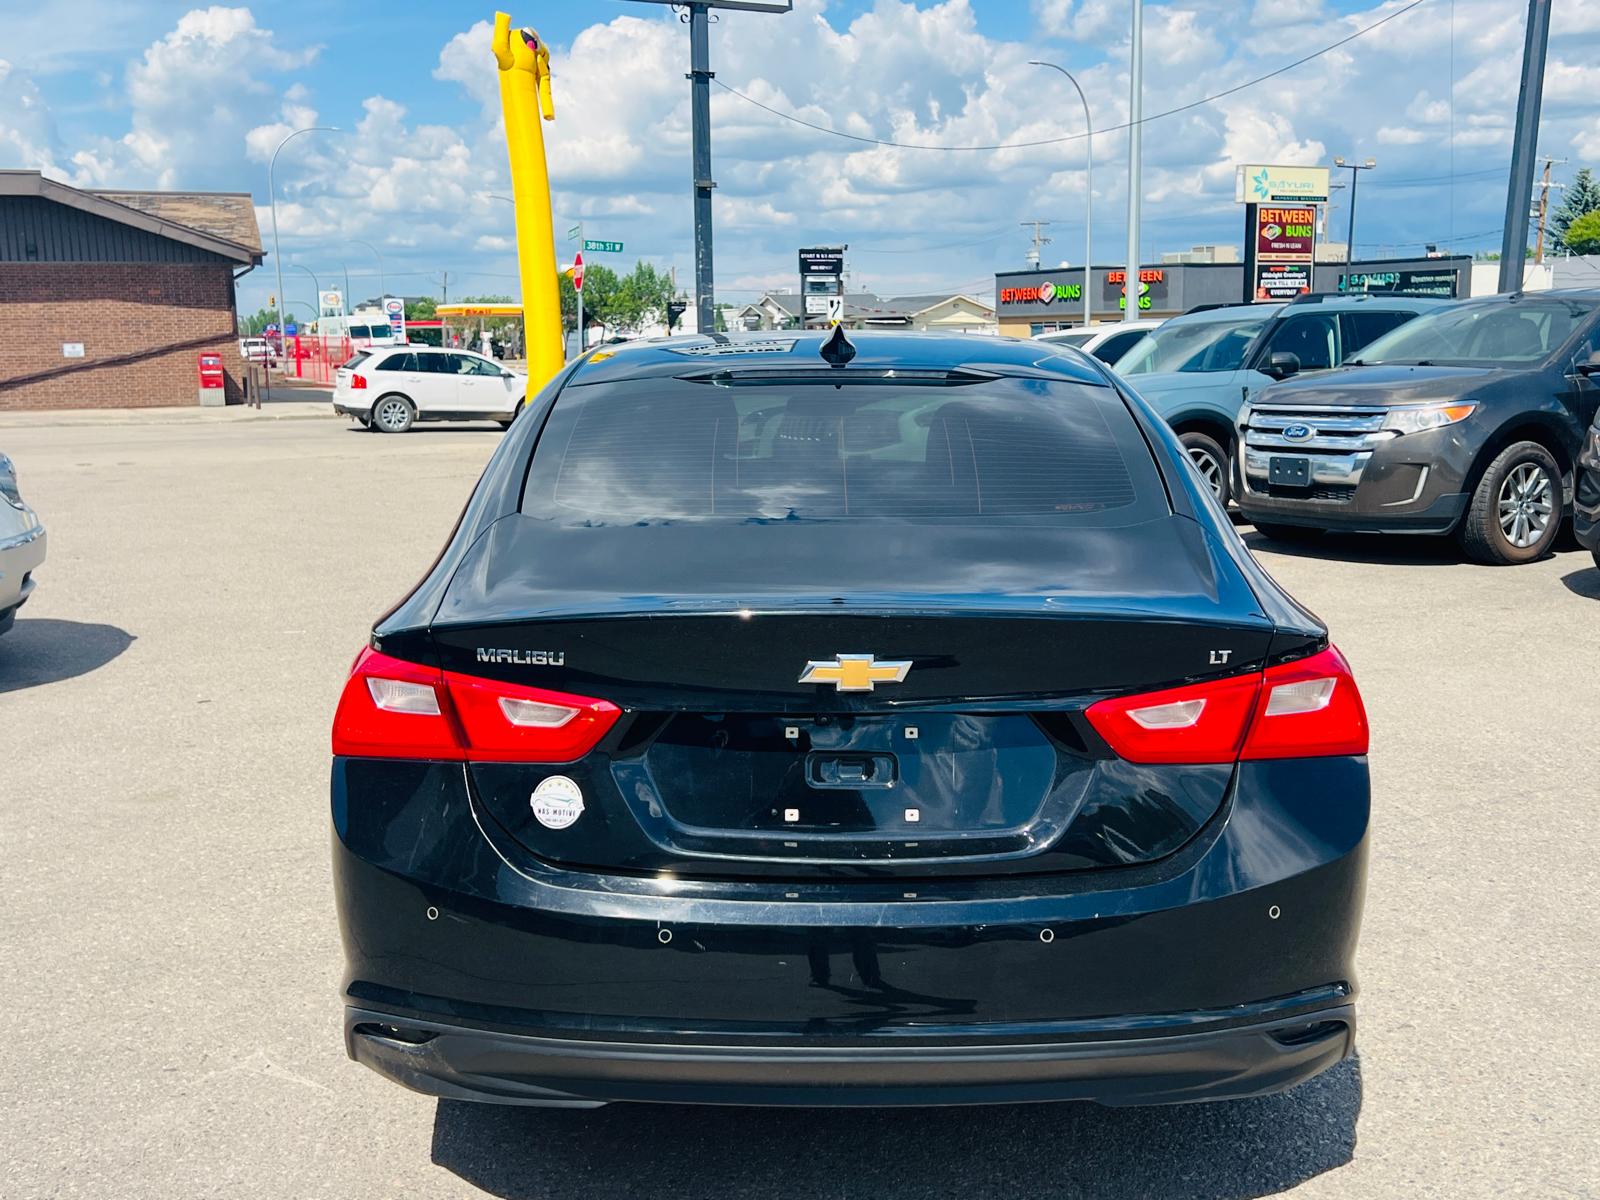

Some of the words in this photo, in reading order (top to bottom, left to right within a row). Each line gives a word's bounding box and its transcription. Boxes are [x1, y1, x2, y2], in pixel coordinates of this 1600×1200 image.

[1268, 180, 1314, 191] SAYURI
[1260, 209, 1313, 223] BETWEEN
[1285, 225, 1312, 238] BUNS
[586, 241, 604, 250] 38th
[1108, 270, 1163, 282] BETEEN
[1001, 288, 1039, 303] BETWEEN
[1057, 284, 1081, 299] BUNS
[1119, 297, 1151, 310] BNS
[476, 647, 565, 666] MALIBU
[1209, 650, 1233, 665] LT
